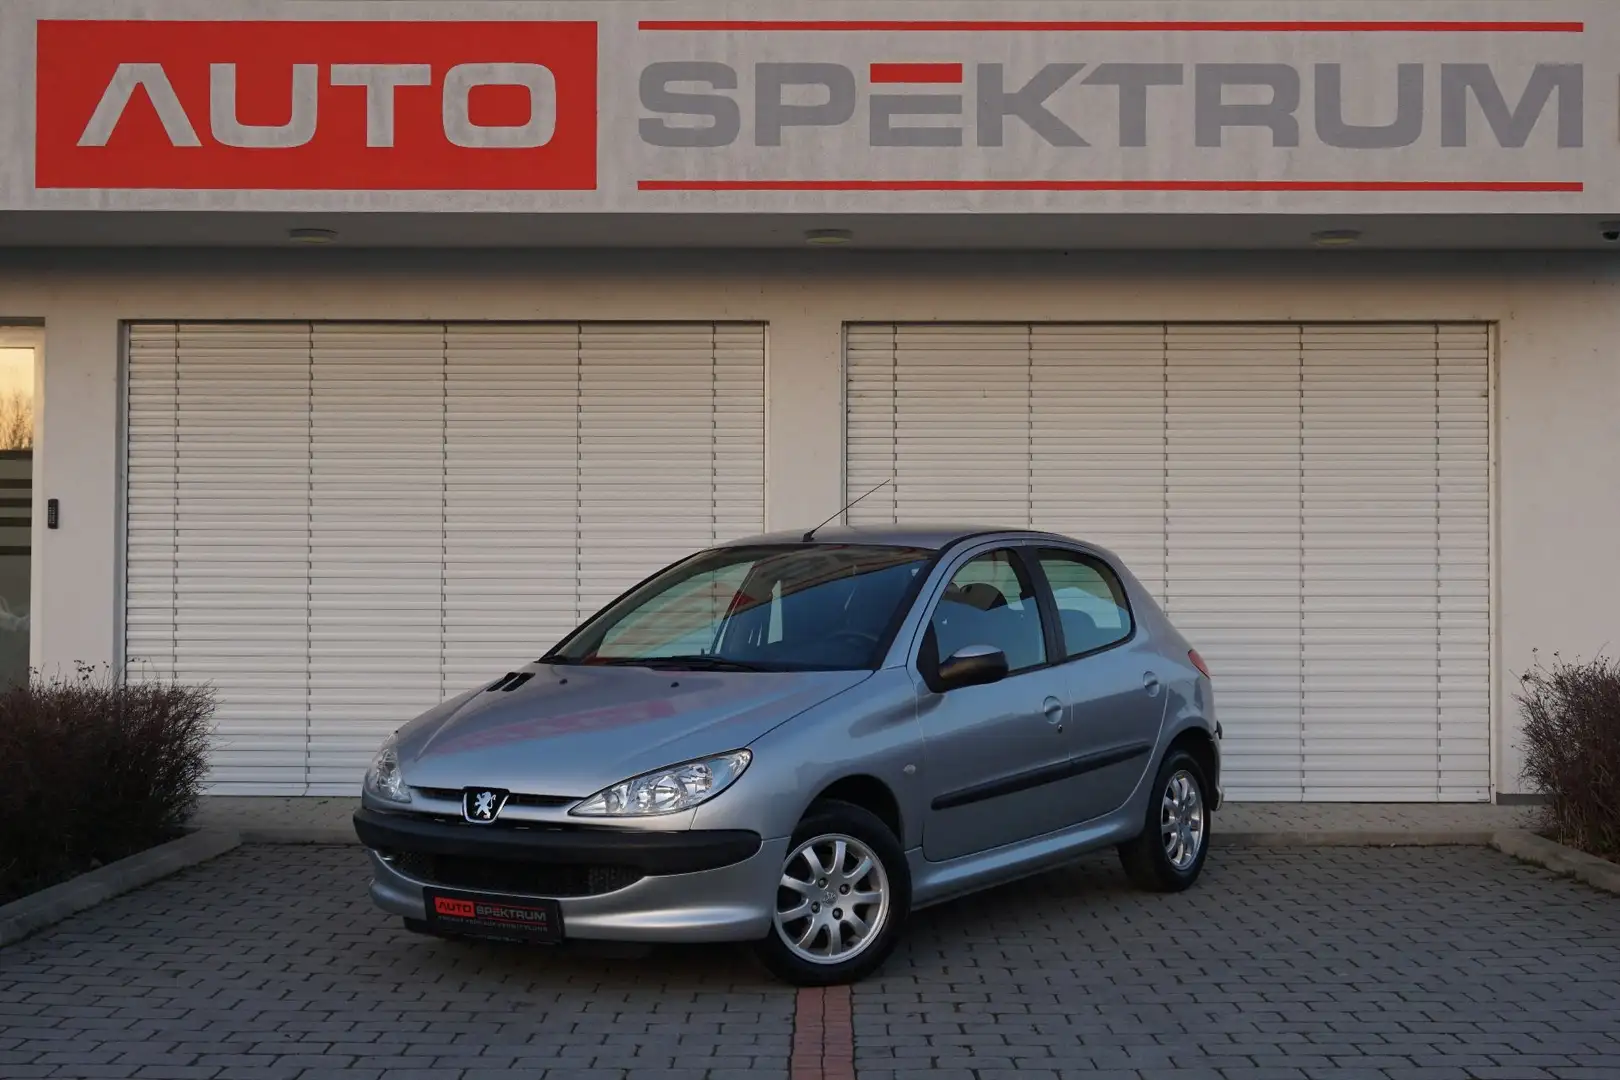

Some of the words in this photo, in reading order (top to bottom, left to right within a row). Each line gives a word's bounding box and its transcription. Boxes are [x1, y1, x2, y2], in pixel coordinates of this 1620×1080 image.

[77, 62, 557, 149] AUTO
[638, 62, 1583, 149] SPEKTRUM
[438, 901, 472, 914] AUTO
[476, 905, 547, 921] SPEKTRUM
